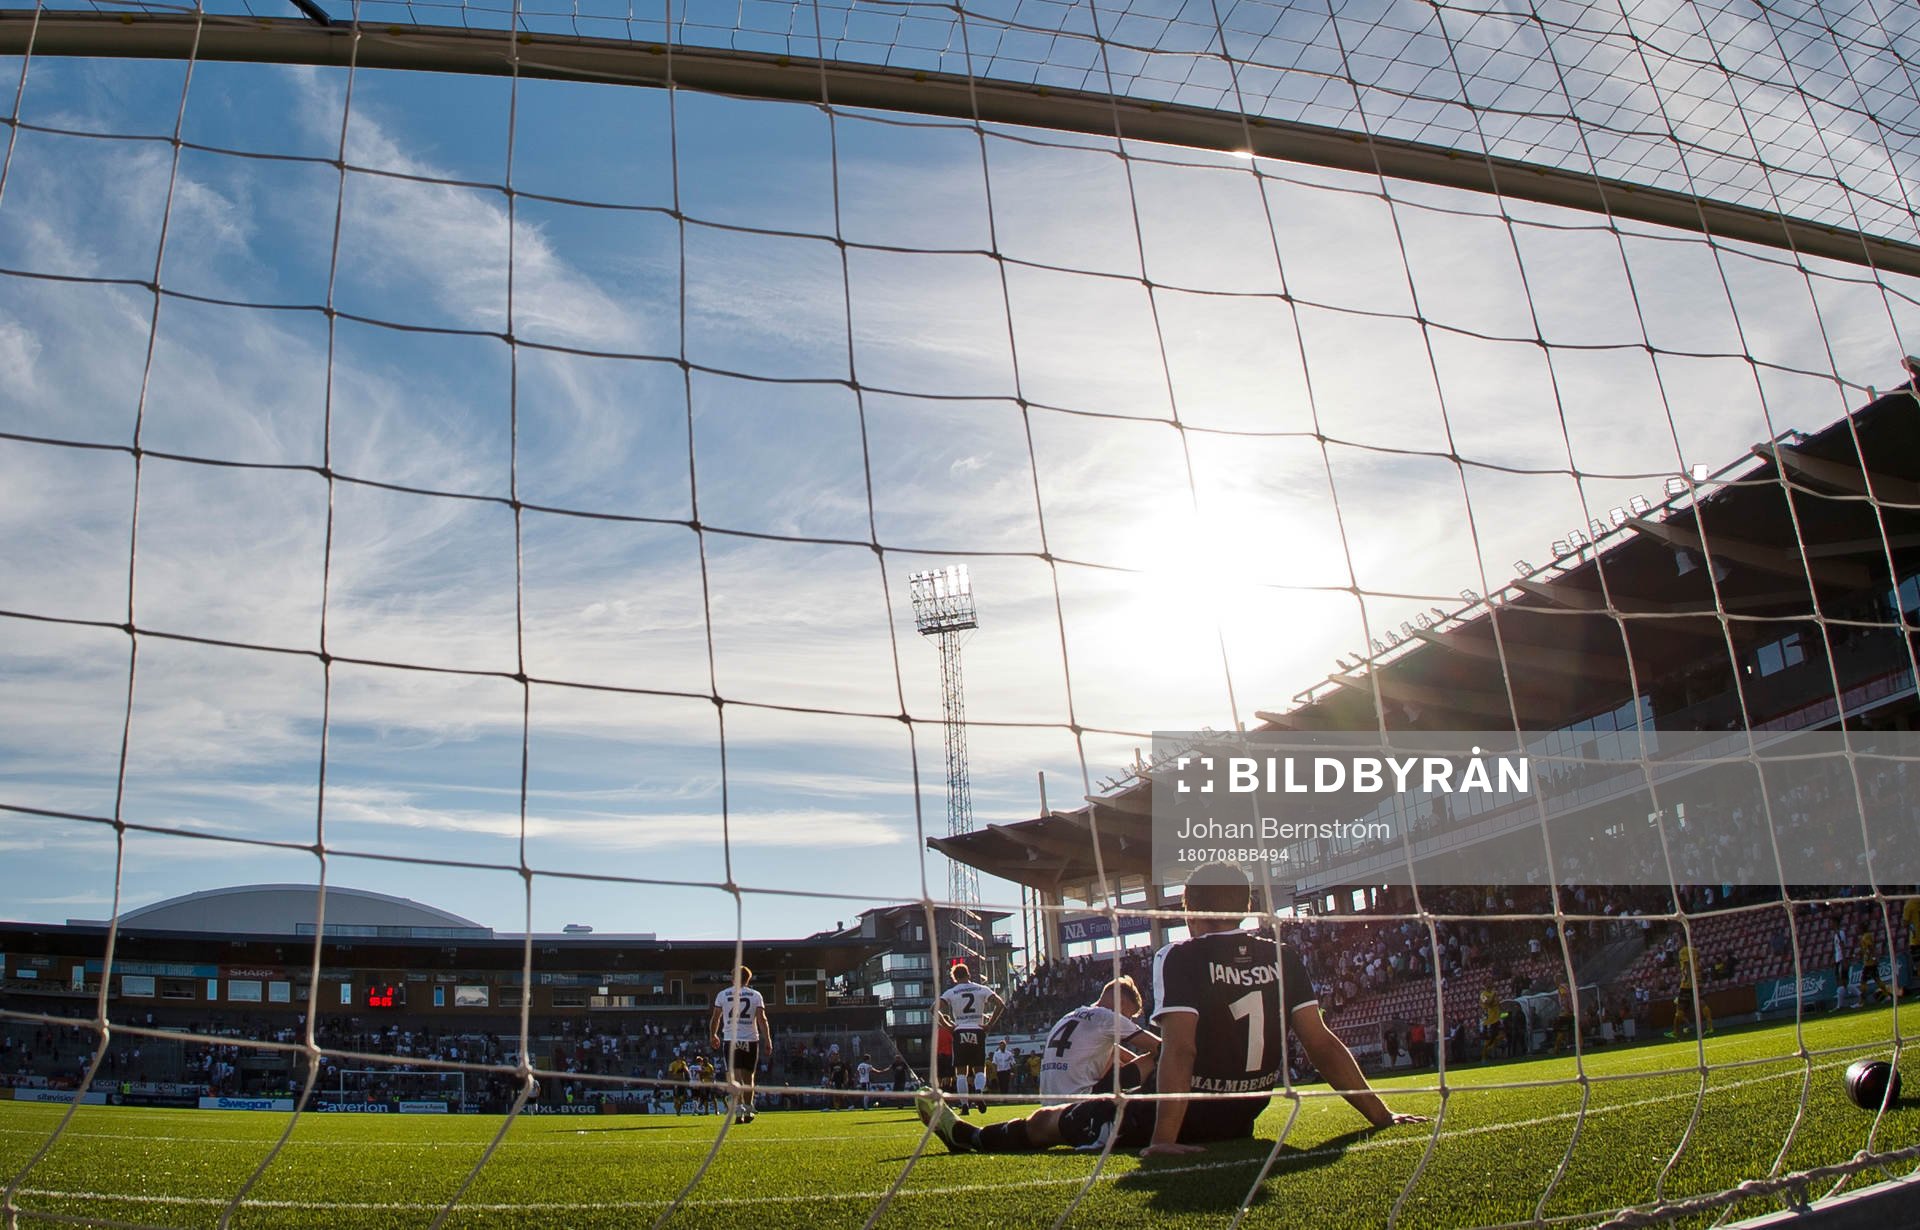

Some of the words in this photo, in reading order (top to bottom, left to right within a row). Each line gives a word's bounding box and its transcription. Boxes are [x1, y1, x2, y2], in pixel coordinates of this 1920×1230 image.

[1064, 923, 1088, 940] NA
[229, 968, 274, 977] SHARP
[962, 993, 976, 1014] 2
[1228, 990, 1265, 1073] 1
[960, 1032, 978, 1045] NA
[1047, 1019, 1081, 1058] 4
[218, 1098, 273, 1110] Swegon
[317, 1101, 389, 1113] Caverion
[540, 1105, 596, 1113] XL-BYGG
